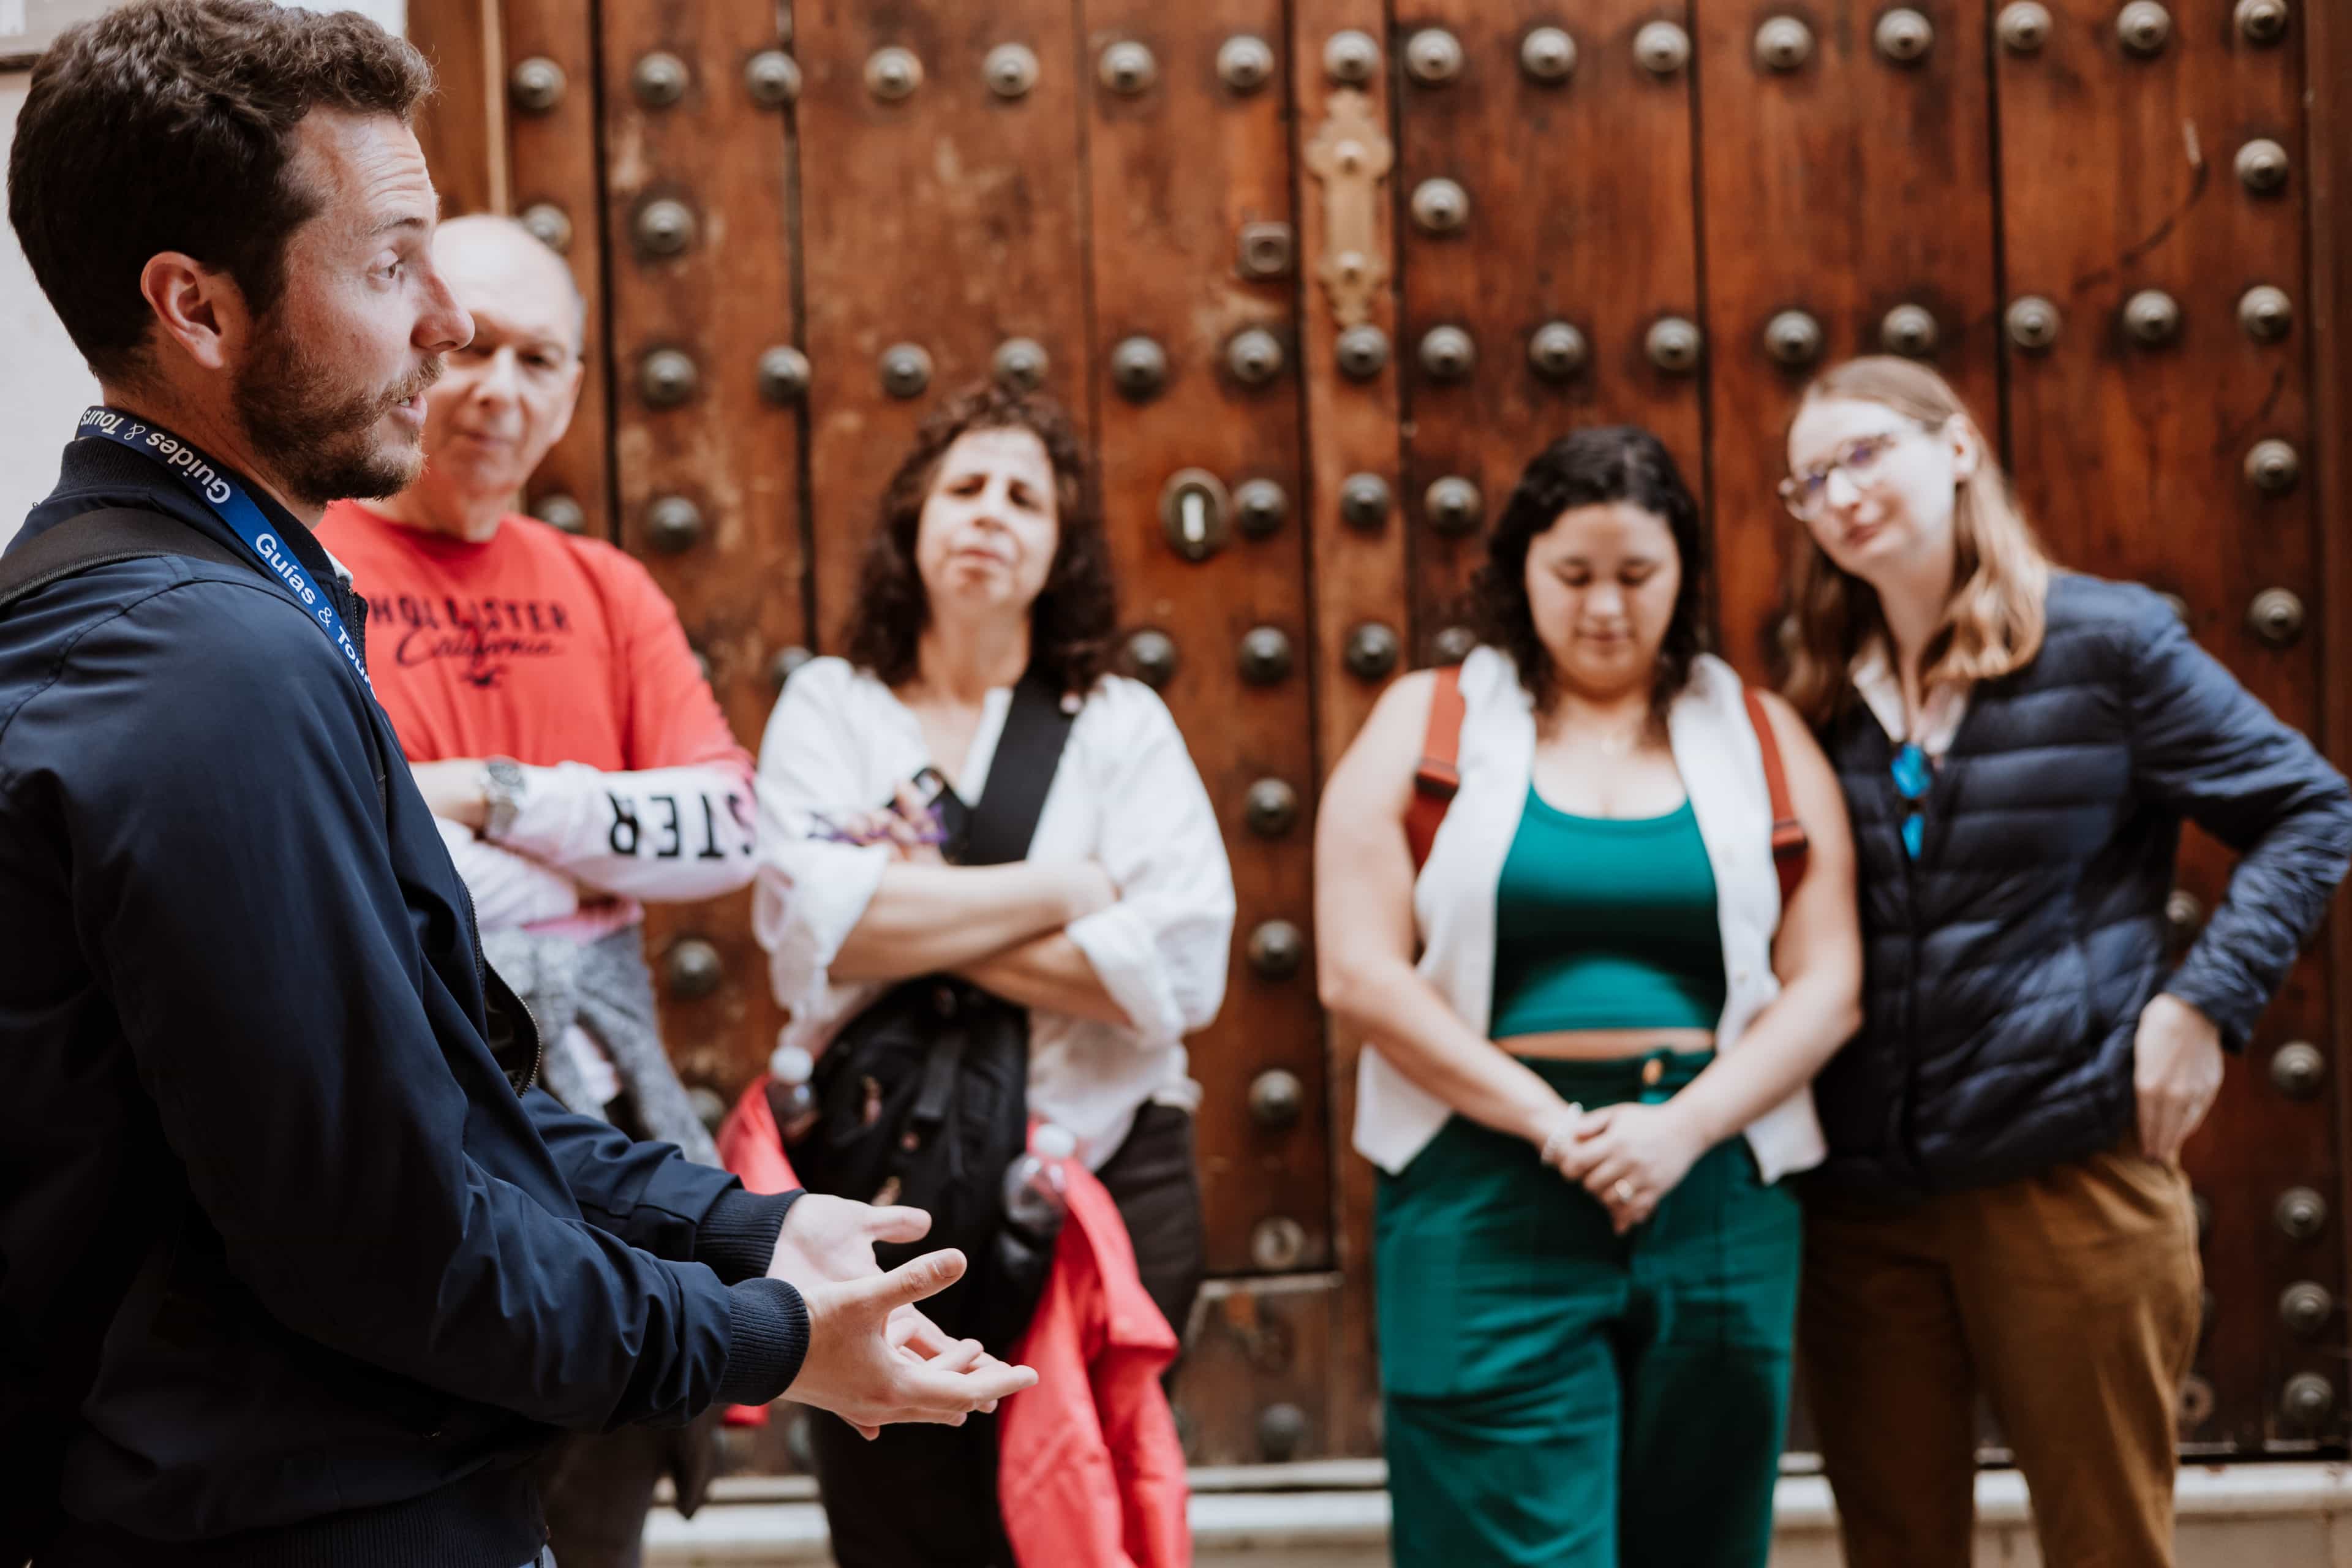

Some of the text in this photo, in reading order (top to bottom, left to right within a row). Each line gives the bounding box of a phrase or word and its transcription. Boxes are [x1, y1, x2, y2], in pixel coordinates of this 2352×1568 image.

[80, 410, 231, 504] Guides & Tours
[255, 533, 316, 605] Guías
[318, 607, 332, 628] &
[606, 784, 758, 859] STER
